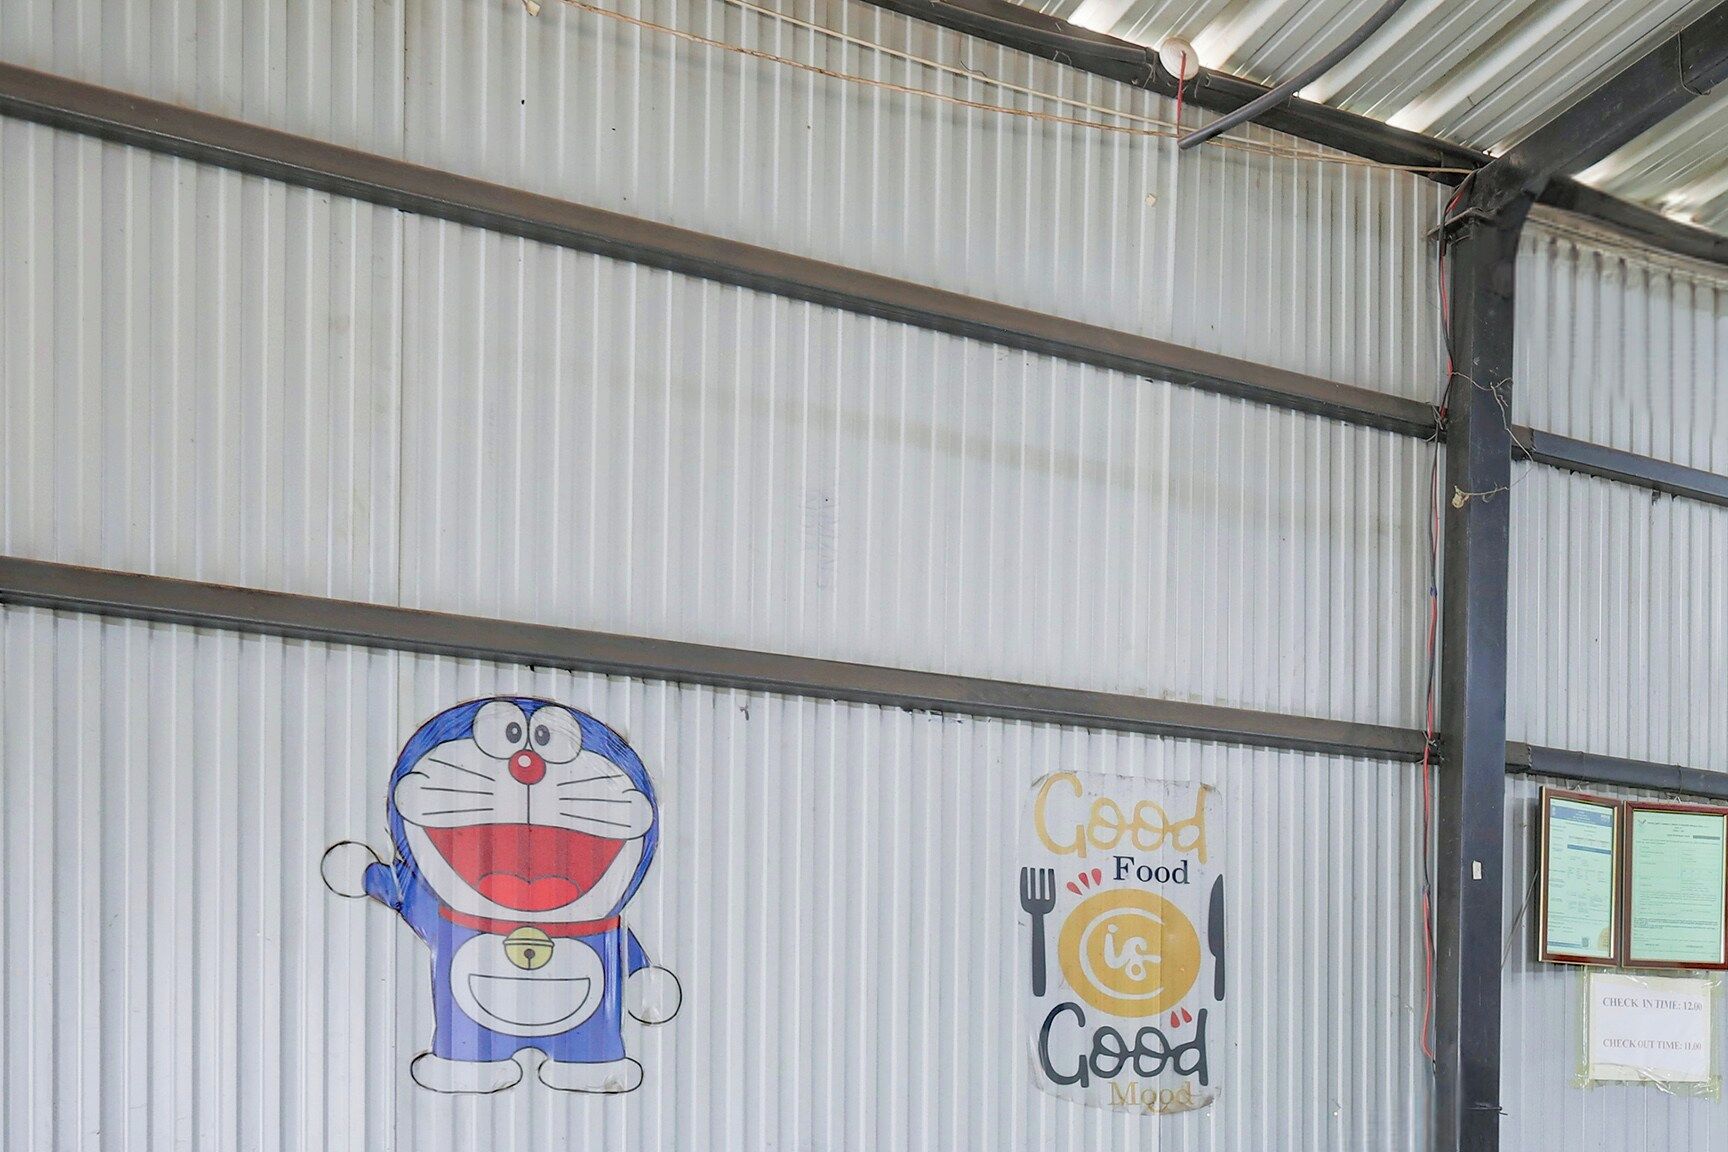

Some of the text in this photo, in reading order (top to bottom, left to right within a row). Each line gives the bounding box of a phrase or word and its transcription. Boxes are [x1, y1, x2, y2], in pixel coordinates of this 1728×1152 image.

[1033, 770, 1209, 865] Good
[1112, 854, 1191, 885] Food
[1103, 923, 1162, 981] is
[1602, 997, 1639, 1008] CHECK
[1642, 999, 1653, 1009] IN
[1655, 999, 1681, 1010] TIME:
[1037, 1000, 1209, 1088] Good
[1602, 1038, 1637, 1049] CHECK
[1637, 1040, 1655, 1049] OUT
[1656, 1040, 1682, 1050] TIME:
[1107, 1080, 1194, 1107] Mood
